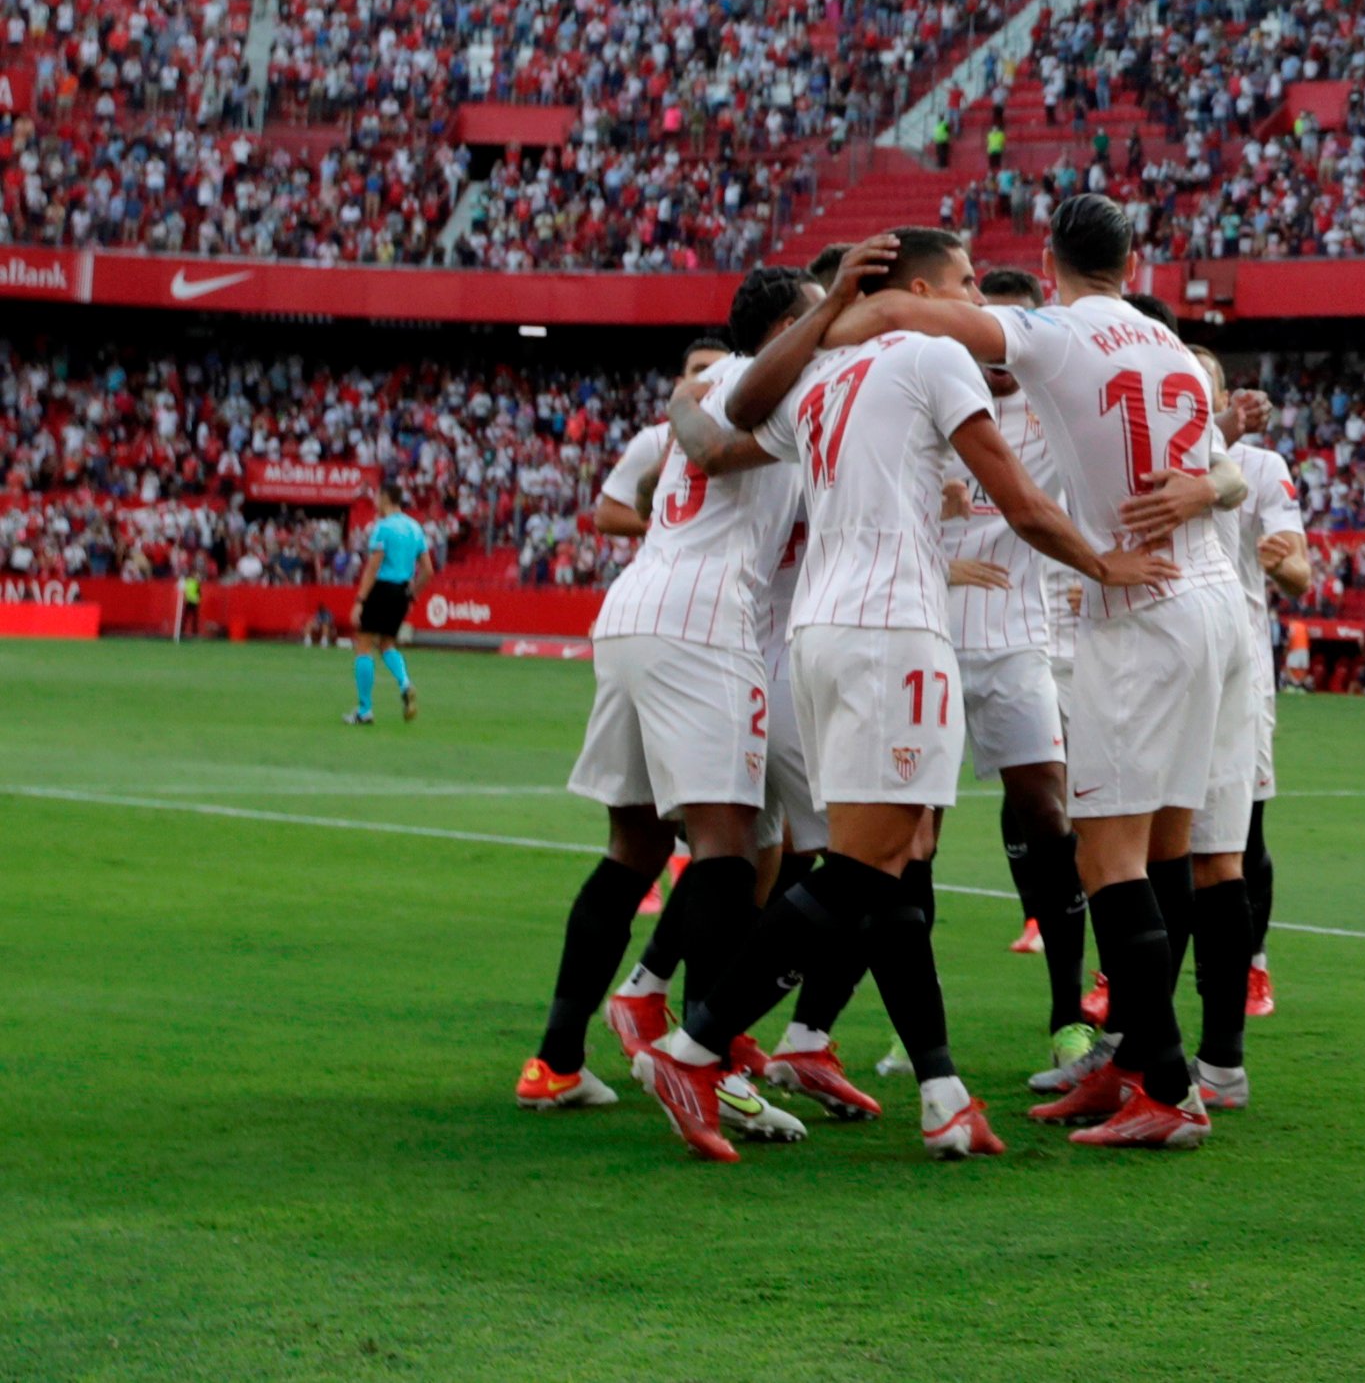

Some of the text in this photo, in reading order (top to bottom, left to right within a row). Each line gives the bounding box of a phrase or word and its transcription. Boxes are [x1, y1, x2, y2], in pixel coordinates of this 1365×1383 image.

[1091, 321, 1152, 357] RAFA
[797, 357, 876, 491] 17
[1098, 369, 1209, 498] 12
[903, 669, 949, 727] 17
